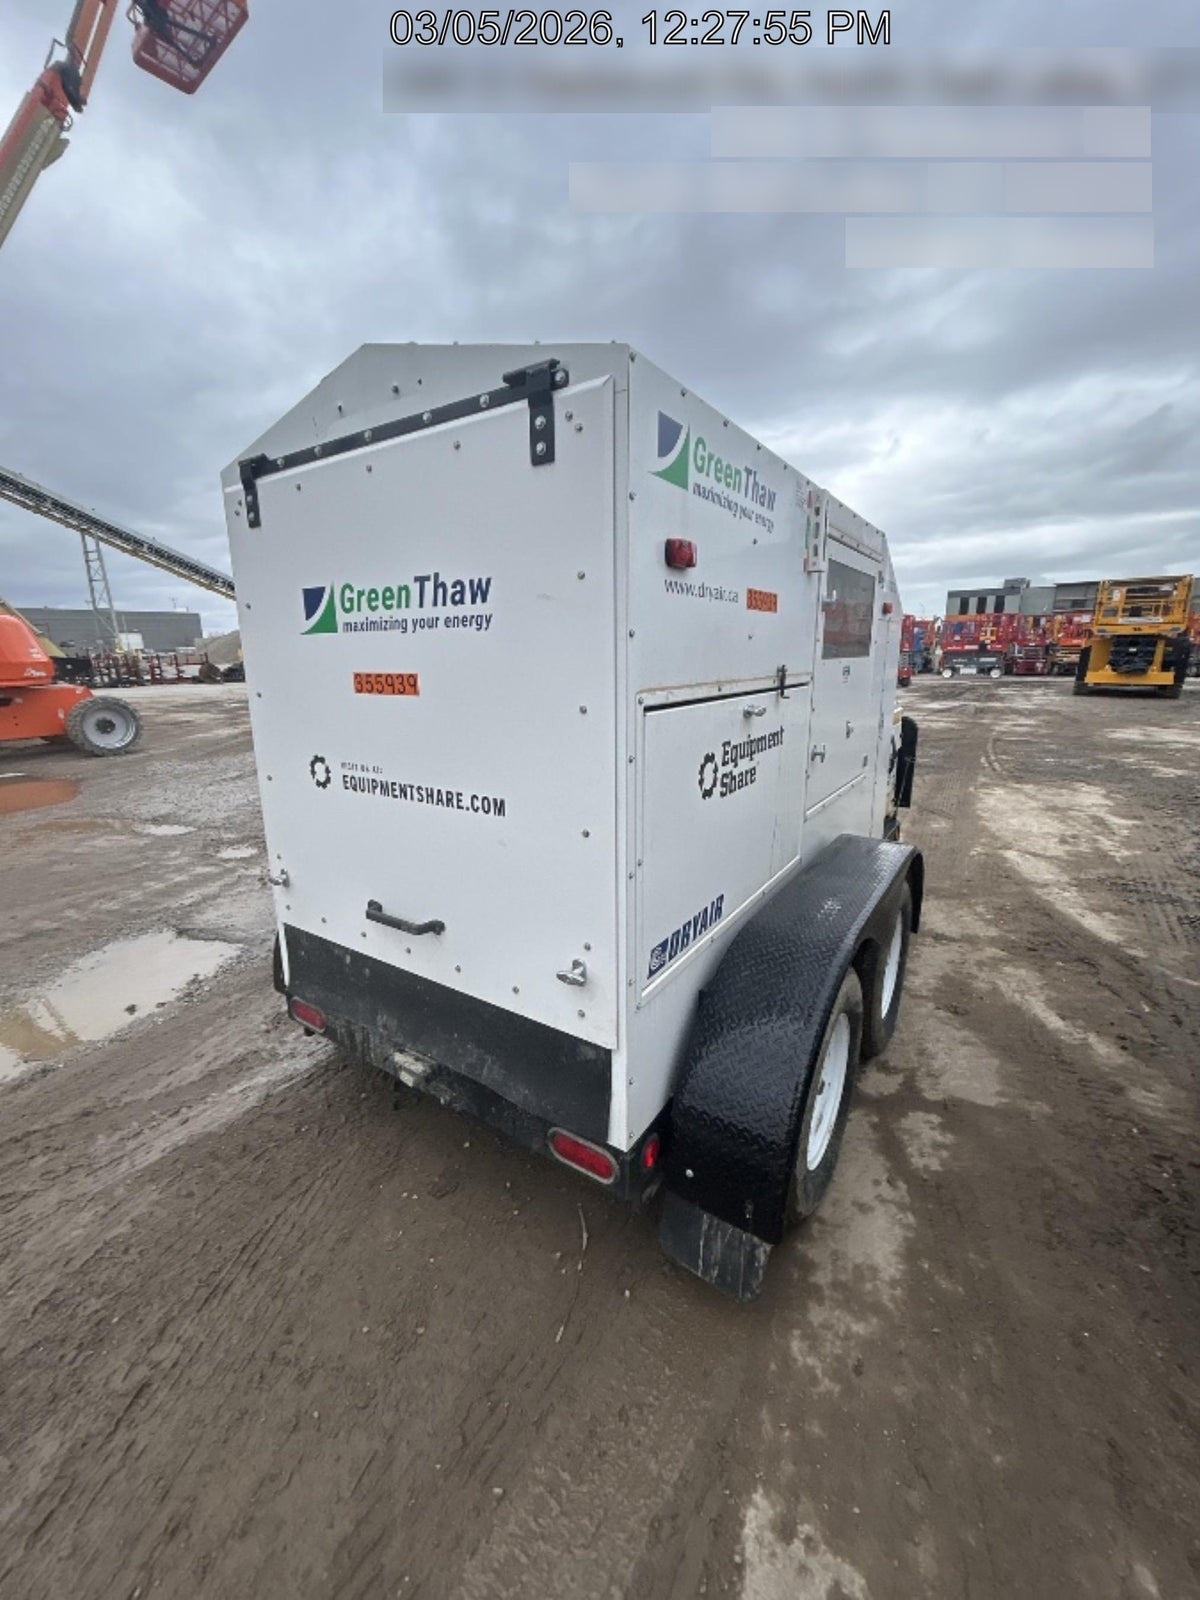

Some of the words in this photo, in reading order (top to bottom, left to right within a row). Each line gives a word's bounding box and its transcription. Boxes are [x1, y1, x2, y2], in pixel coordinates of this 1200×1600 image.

[340, 572, 492, 614] GreenThaw
[664, 579, 739, 604] www.dryair.ca
[343, 616, 408, 634] maximizing
[411, 616, 440, 633] your
[444, 614, 493, 632] energy
[721, 726, 785, 768] Equipment
[342, 774, 506, 817] EQUIPMENTSHARE.COM
[719, 767, 757, 798] Share
[668, 894, 724, 962] DRYAIR
